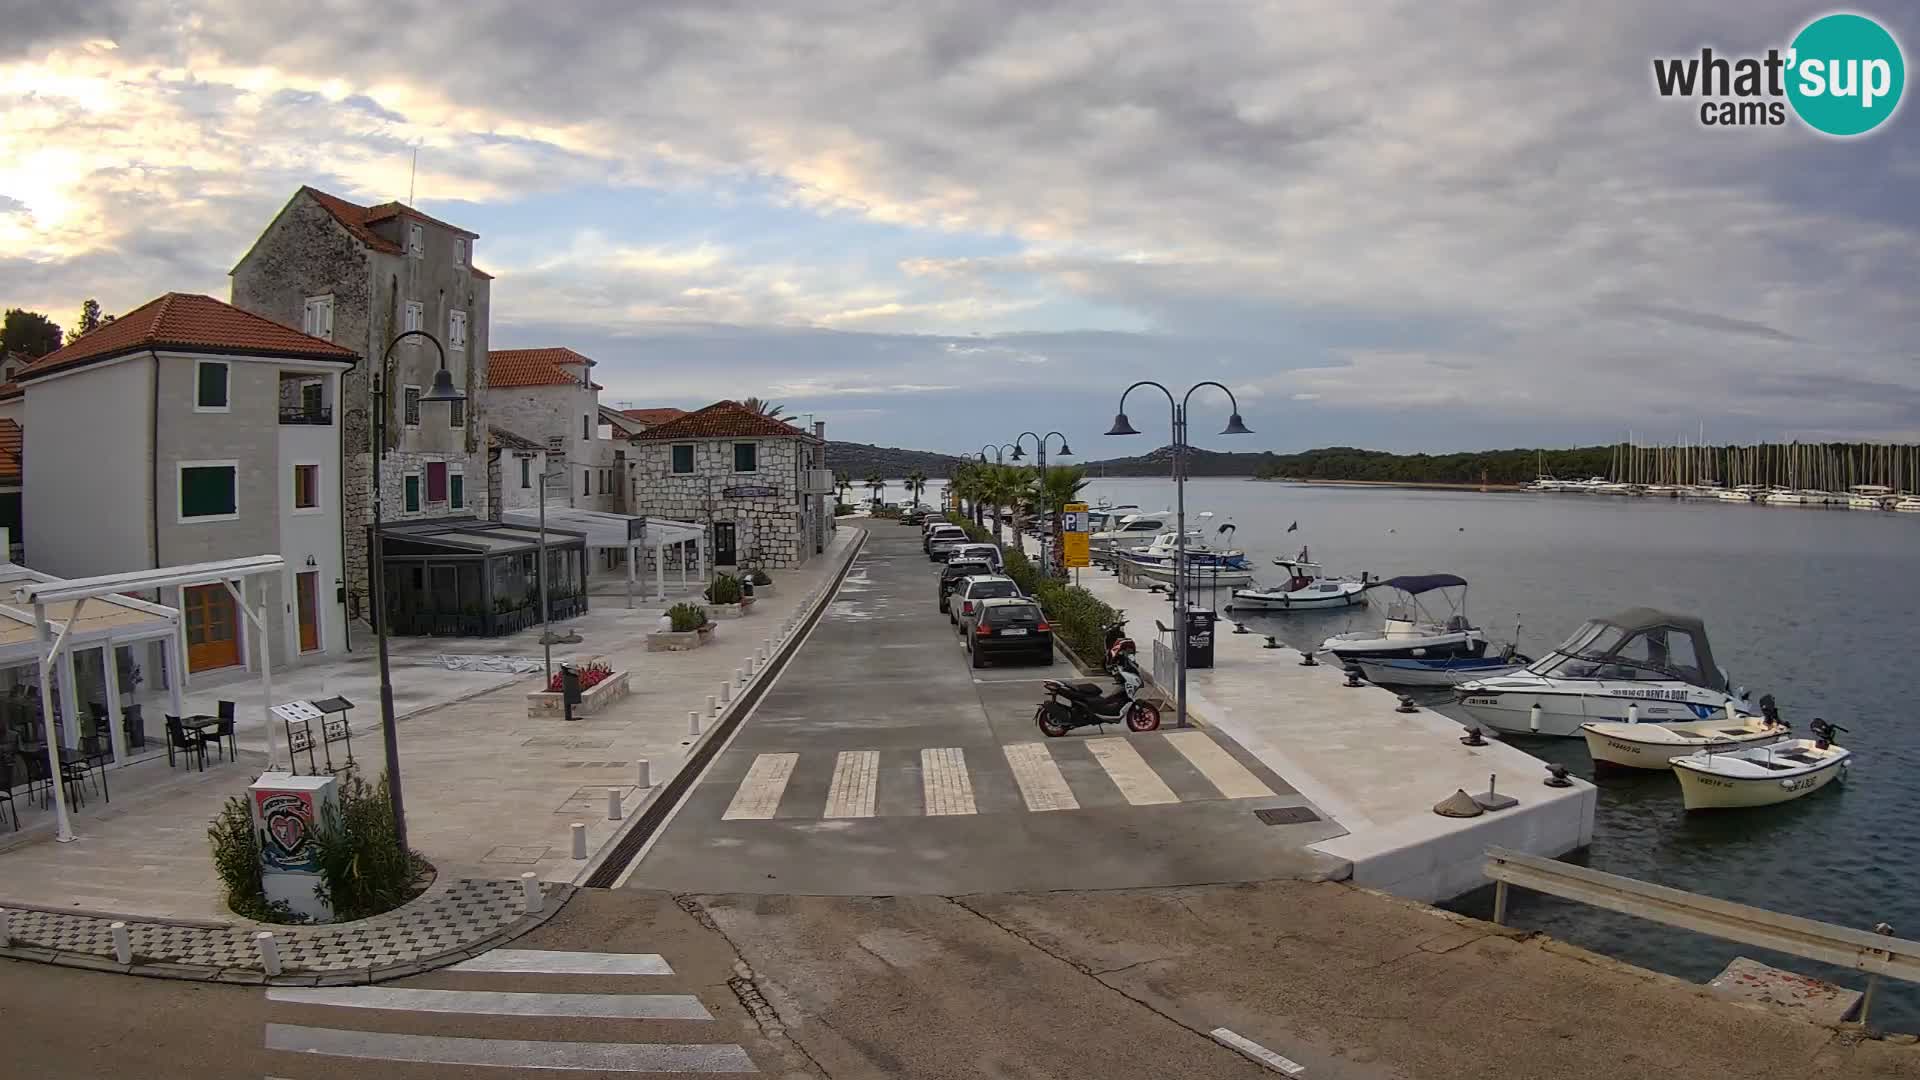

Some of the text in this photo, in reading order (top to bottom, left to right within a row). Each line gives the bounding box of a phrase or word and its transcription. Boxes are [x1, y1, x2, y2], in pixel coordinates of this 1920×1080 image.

[1065, 514, 1076, 530] P
[1645, 689, 1665, 699] RENT
[1665, 690, 1671, 699] A
[1671, 690, 1689, 701] BOAT
